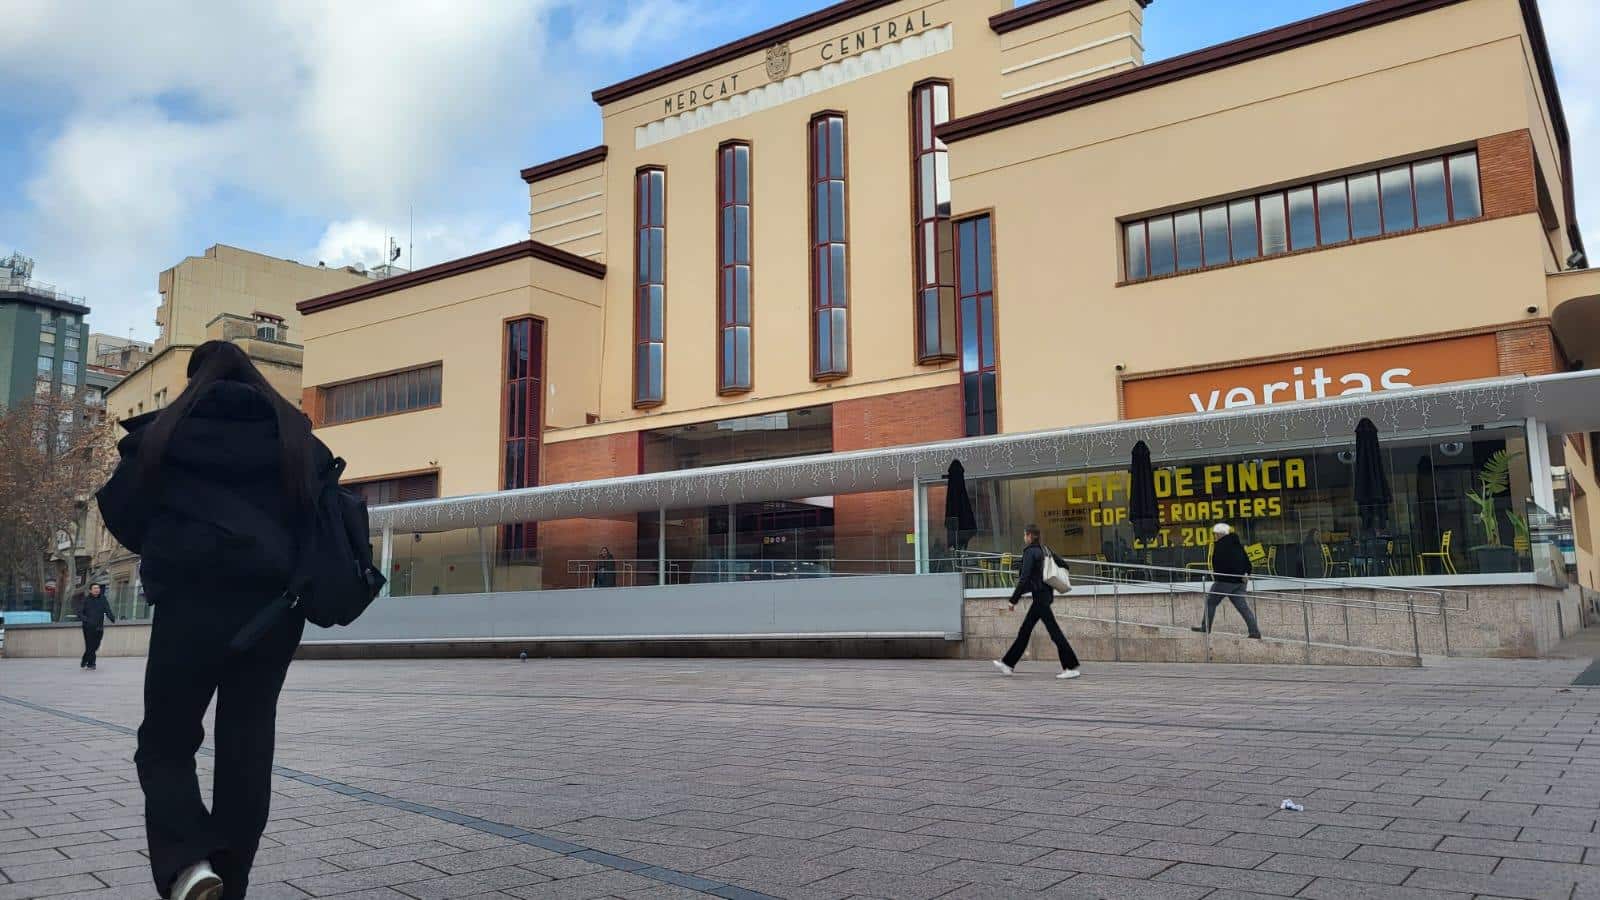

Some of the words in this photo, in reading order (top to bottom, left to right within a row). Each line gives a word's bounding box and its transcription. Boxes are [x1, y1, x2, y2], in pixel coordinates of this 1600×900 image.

[664, 74, 738, 114] MERCAT
[821, 10, 931, 60] CENTRAL
[1189, 367, 1414, 412] veritas
[1153, 467, 1194, 498] DE
[1204, 458, 1306, 495] FINCA
[1171, 497, 1281, 522] ROASTERS
